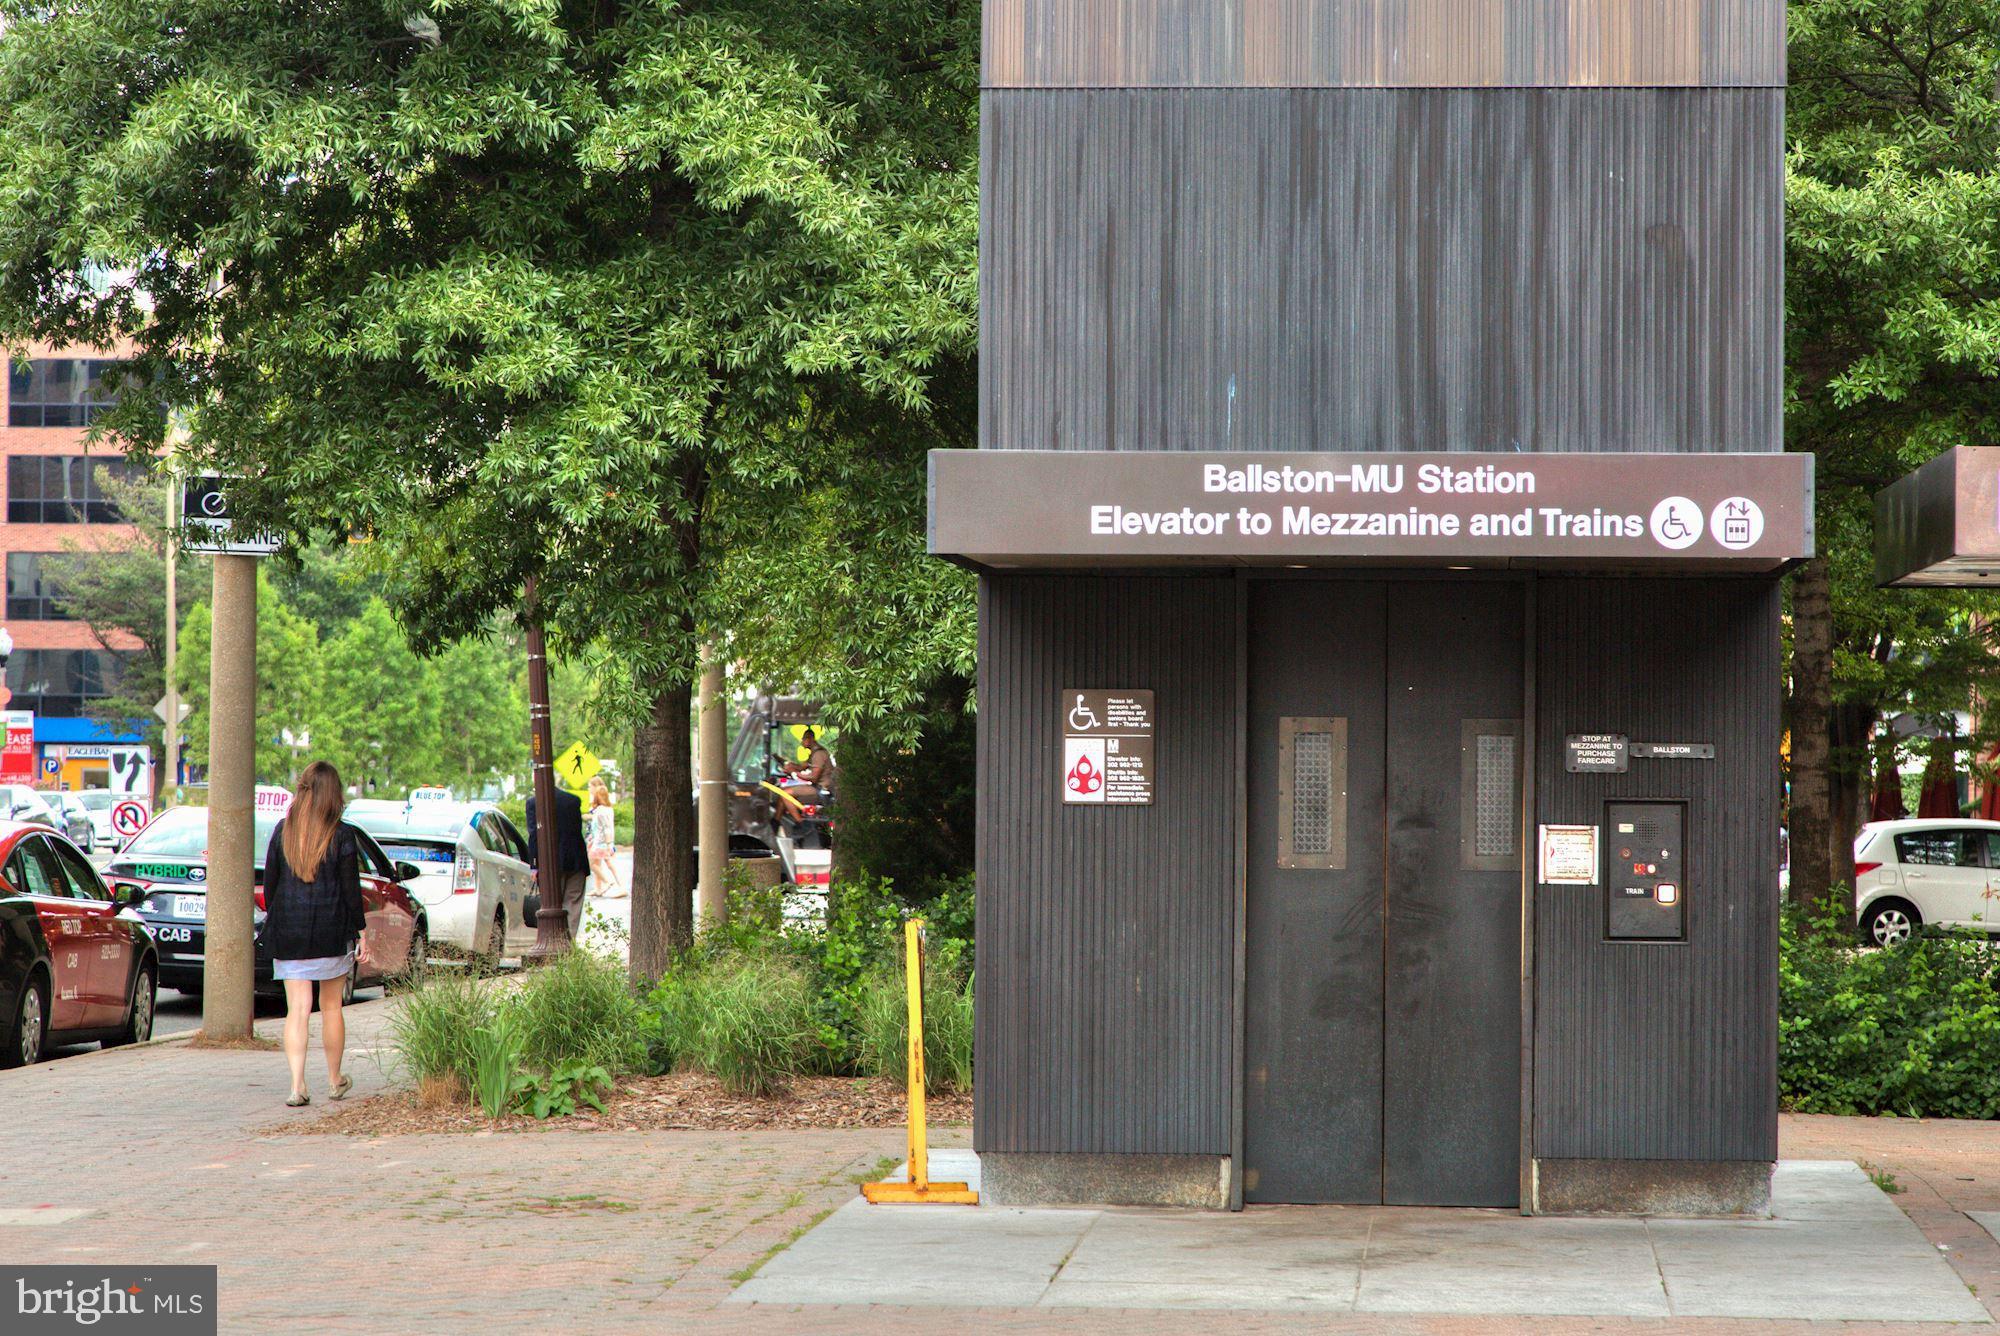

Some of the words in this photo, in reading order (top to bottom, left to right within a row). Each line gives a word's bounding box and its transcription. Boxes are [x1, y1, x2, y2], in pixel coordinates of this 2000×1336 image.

[1204, 464, 1403, 493] Ballston-MU
[1417, 463, 1536, 494] Station
[1091, 505, 1230, 536] Elevator
[1236, 507, 1272, 536] to
[1282, 506, 1460, 537] Mezzanine
[1469, 508, 1532, 537] and
[1539, 507, 1644, 537] Trains
[1653, 746, 1691, 754] BALLSTON
[416, 791, 431, 800] BLUE
[135, 863, 188, 878] HYBRID
[61, 919, 72, 935] RED
[72, 919, 82, 935] TOP
[159, 927, 192, 943] CAB
[67, 953, 78, 969] CAB
